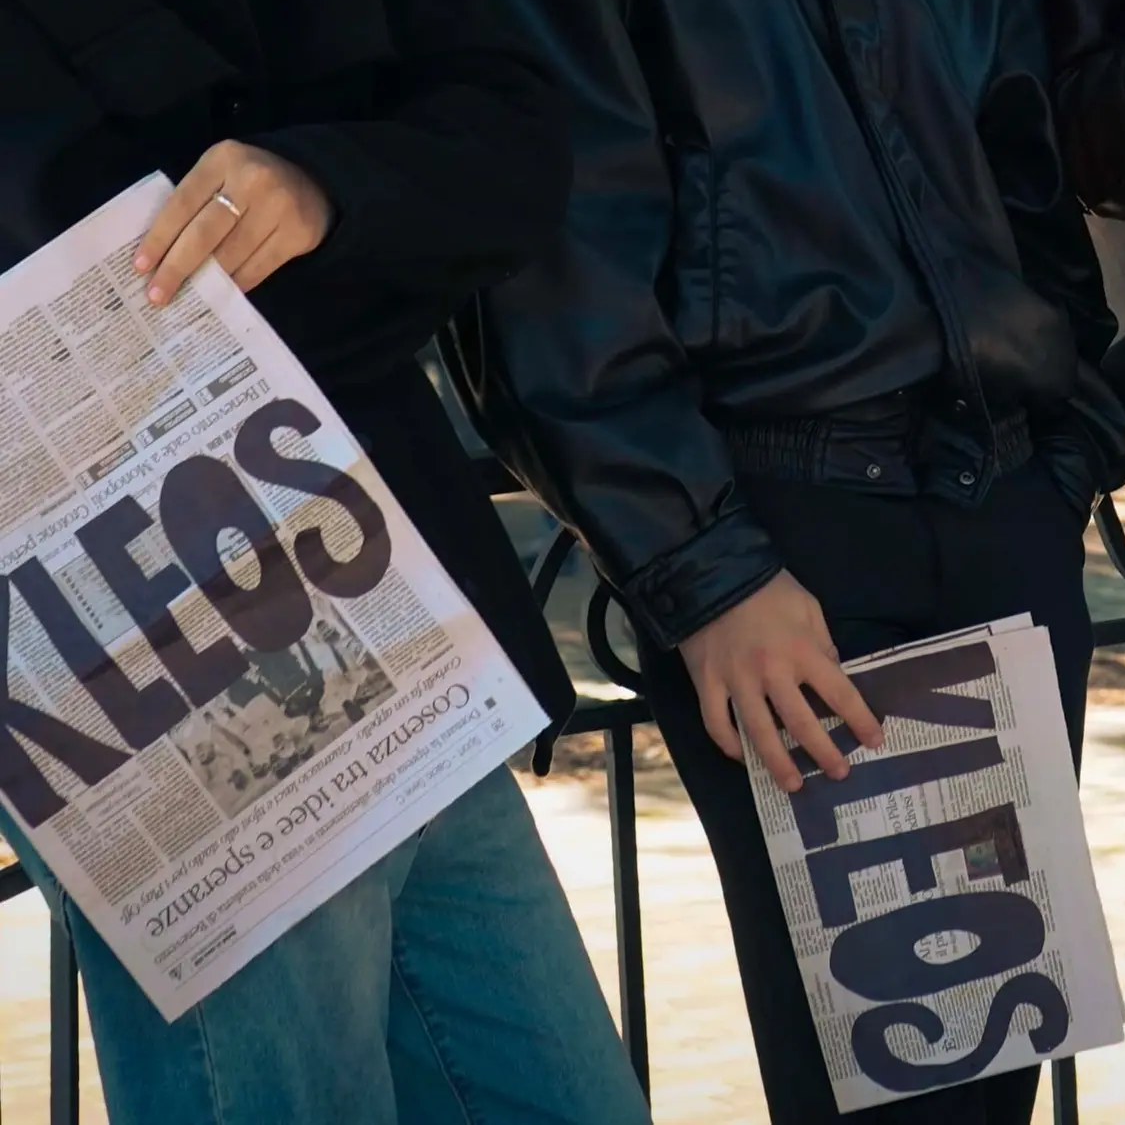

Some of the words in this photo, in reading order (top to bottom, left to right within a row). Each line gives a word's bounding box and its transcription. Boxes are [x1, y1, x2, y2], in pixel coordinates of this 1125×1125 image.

[190, 384, 260, 435] Benevento
[159, 430, 191, 457] cade
[90, 458, 154, 509] Monopoli
[36, 503, 90, 543] Crotone
[366, 682, 470, 764] Cosenza
[329, 759, 368, 792] tra
[275, 786, 334, 835] idee
[254, 830, 274, 851] e
[146, 844, 255, 936] speranze
